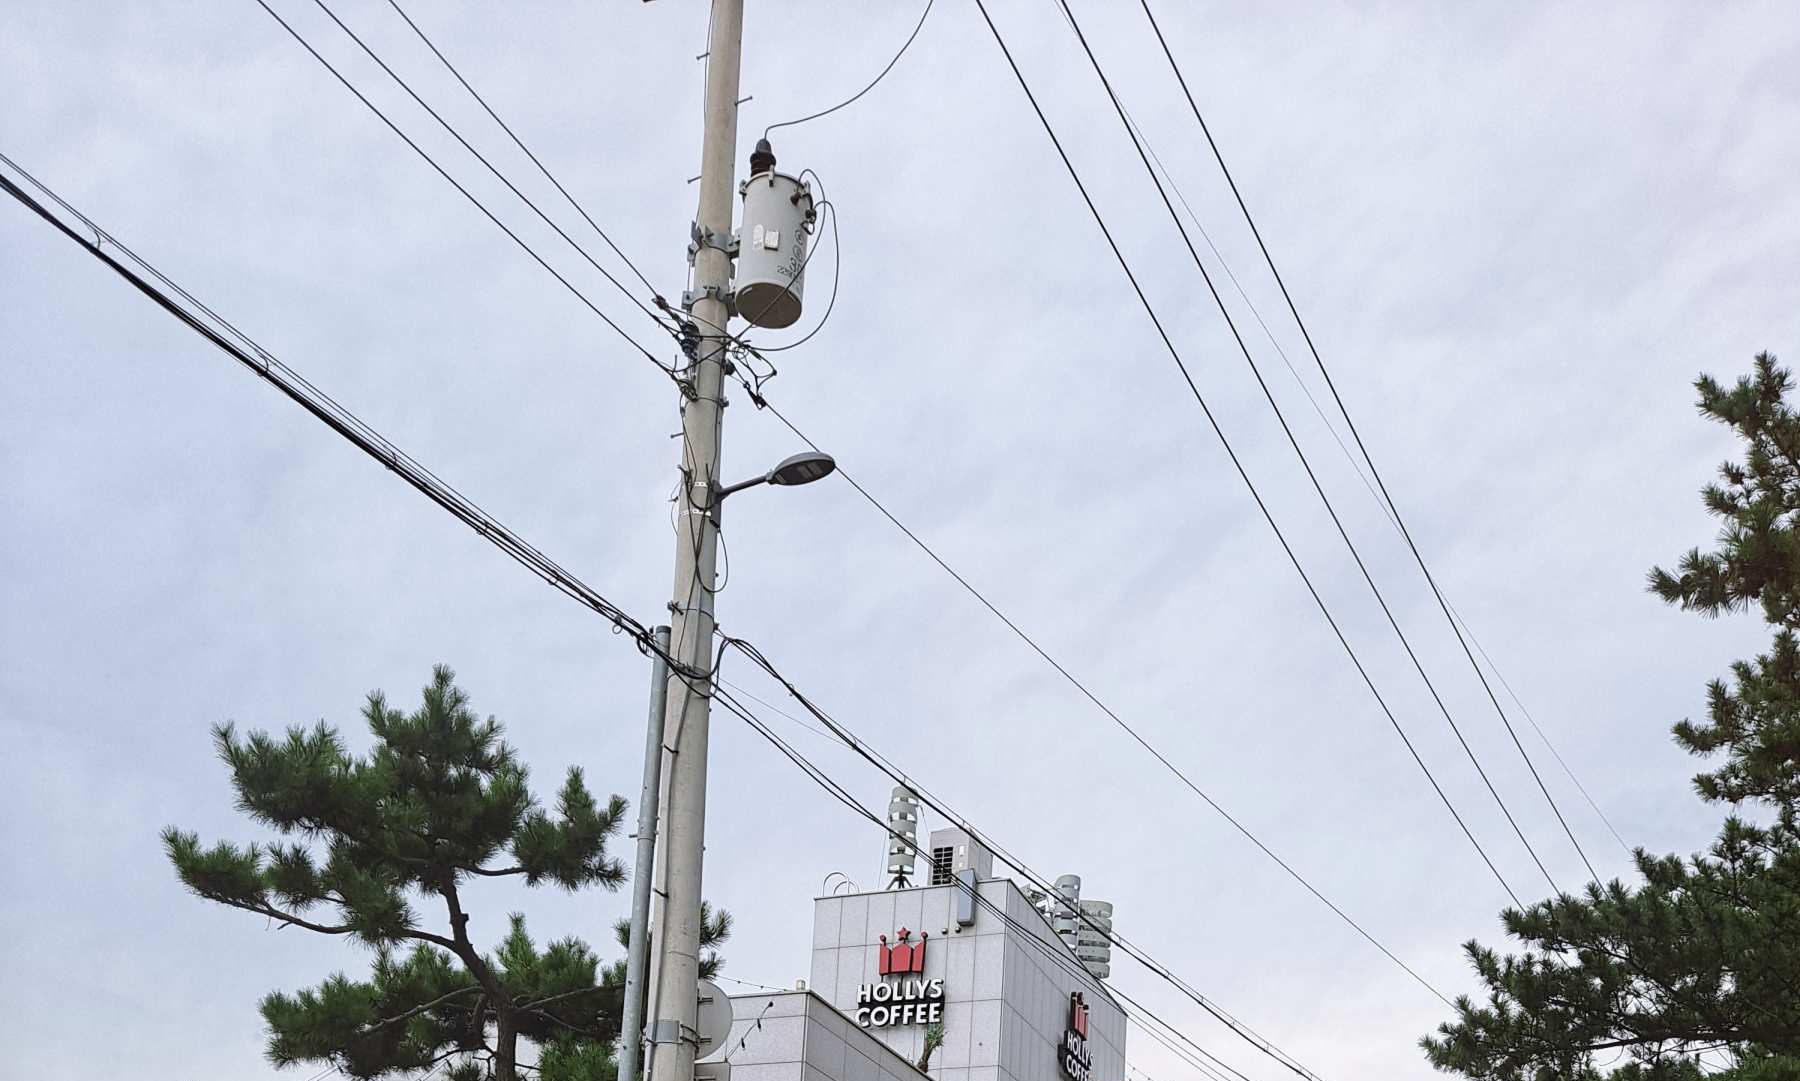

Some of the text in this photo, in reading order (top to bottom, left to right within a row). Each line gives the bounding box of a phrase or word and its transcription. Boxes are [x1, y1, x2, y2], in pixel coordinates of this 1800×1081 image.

[857, 978, 944, 1003] HOLLYS
[855, 1002, 941, 1028] COFFEE
[1067, 1030, 1095, 1070] HOLLYS
